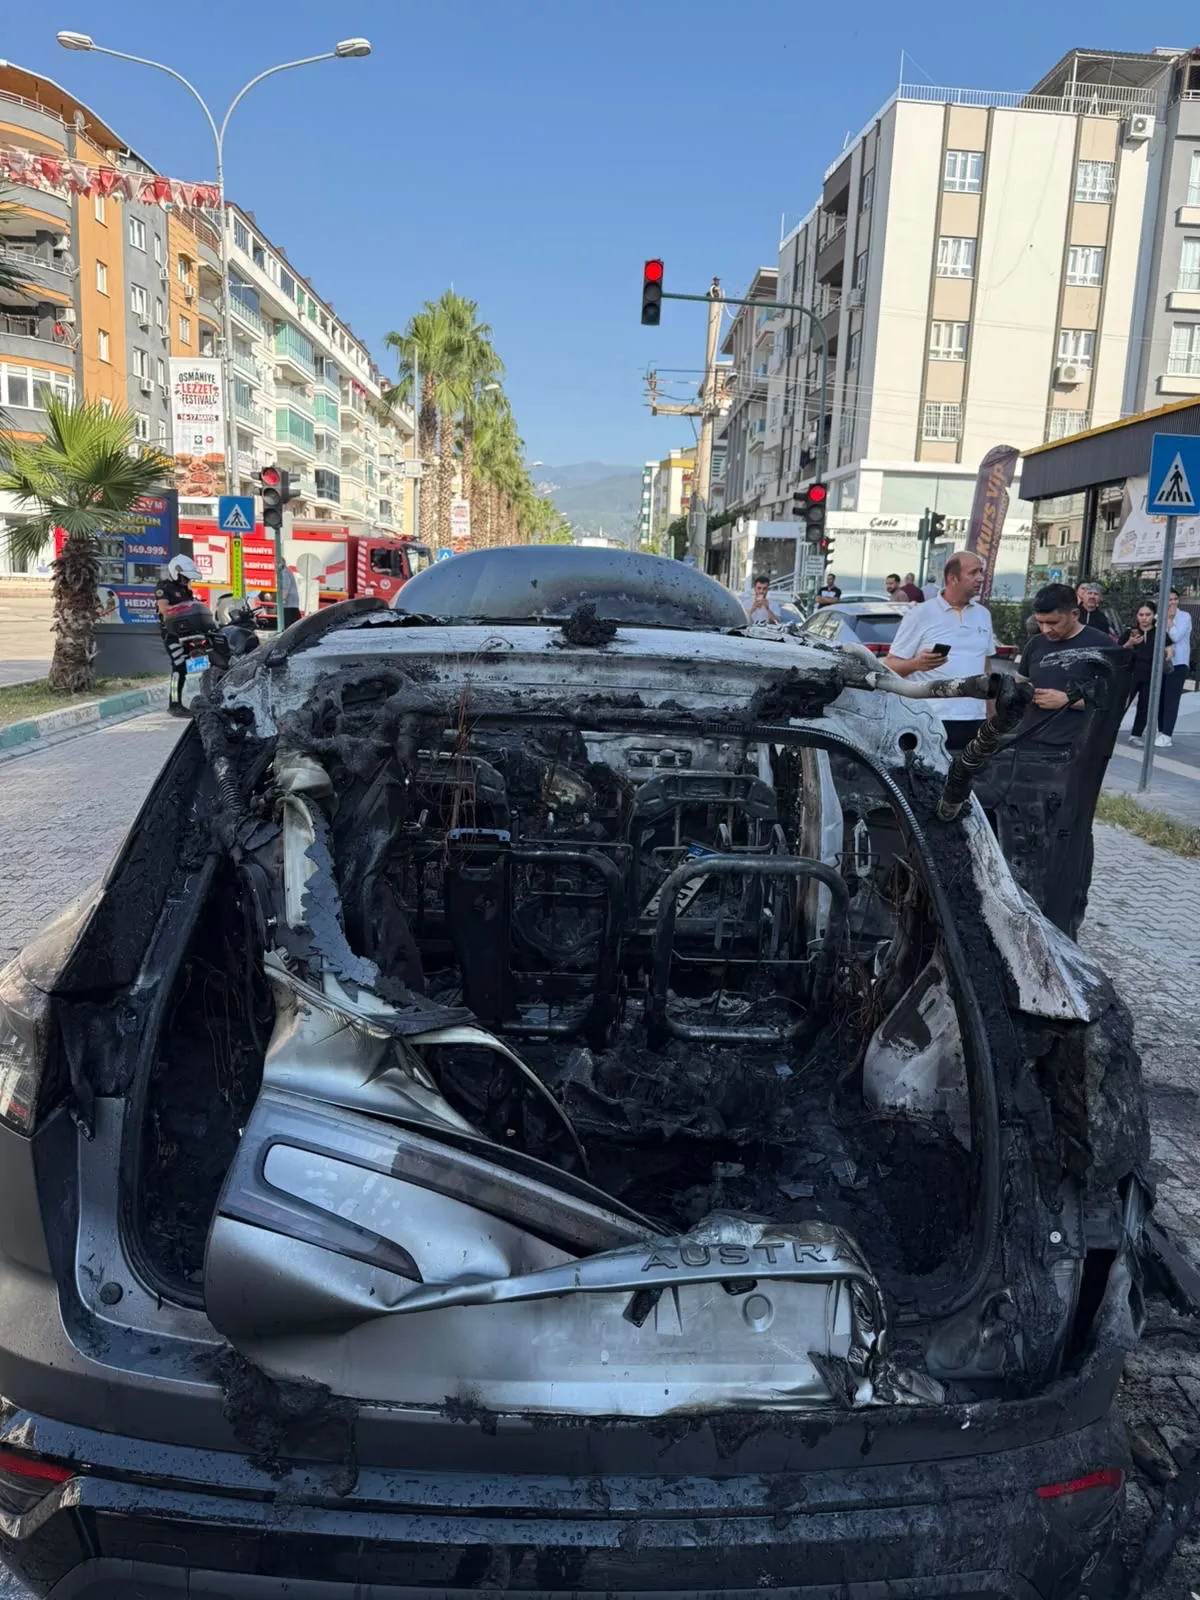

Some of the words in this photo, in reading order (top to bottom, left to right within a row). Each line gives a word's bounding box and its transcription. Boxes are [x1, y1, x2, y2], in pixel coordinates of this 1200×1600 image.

[178, 371, 216, 385] OSMANİYE
[181, 383, 214, 395] LEZZET
[196, 556, 211, 567] 112
[124, 597, 157, 608] HEDİY
